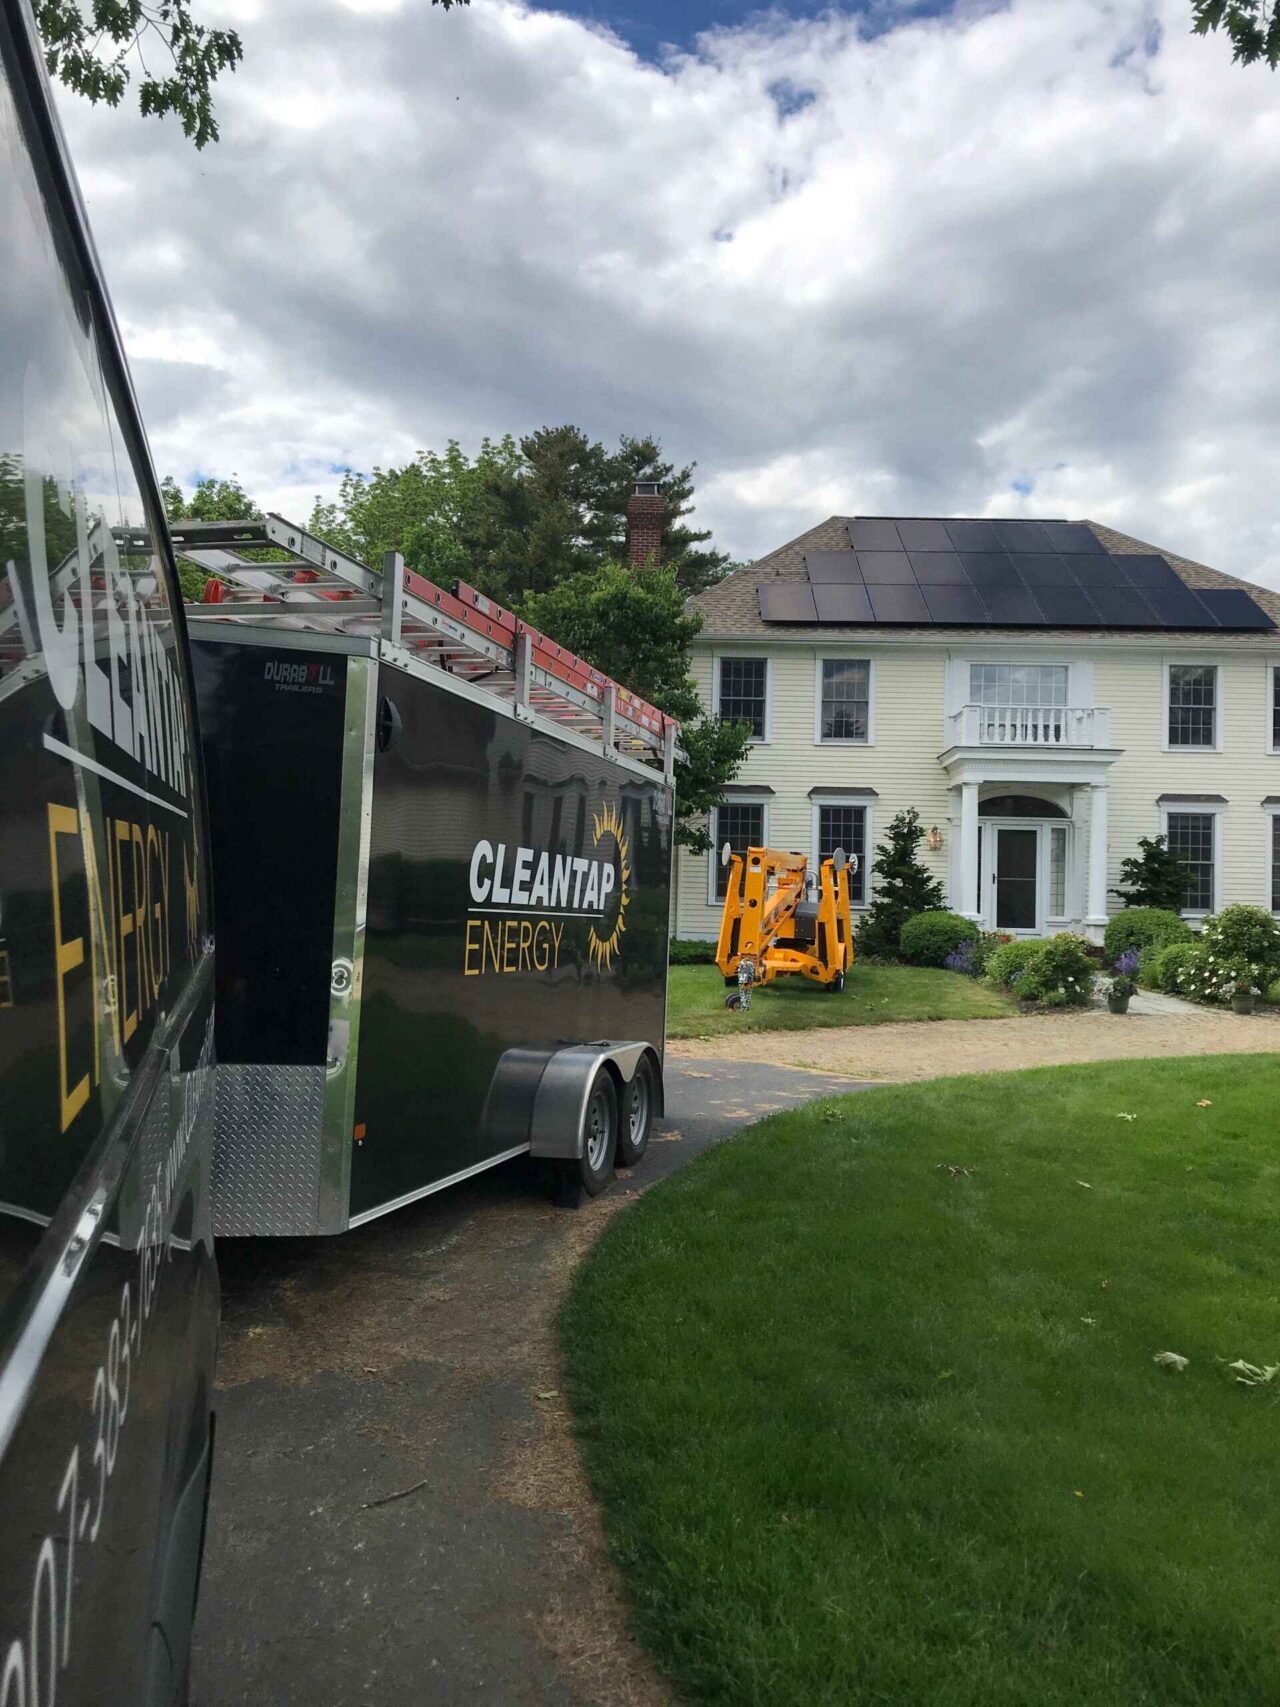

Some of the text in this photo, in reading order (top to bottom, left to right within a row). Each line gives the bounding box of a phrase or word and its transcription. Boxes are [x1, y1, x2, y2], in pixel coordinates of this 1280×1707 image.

[23, 361, 188, 798] CLEANTAP
[48, 803, 171, 1133] ENERGY
[464, 920, 564, 976] ENERGY
[469, 840, 615, 910] CLEANTAP
[0, 1162, 162, 1707] 07-383-7635
